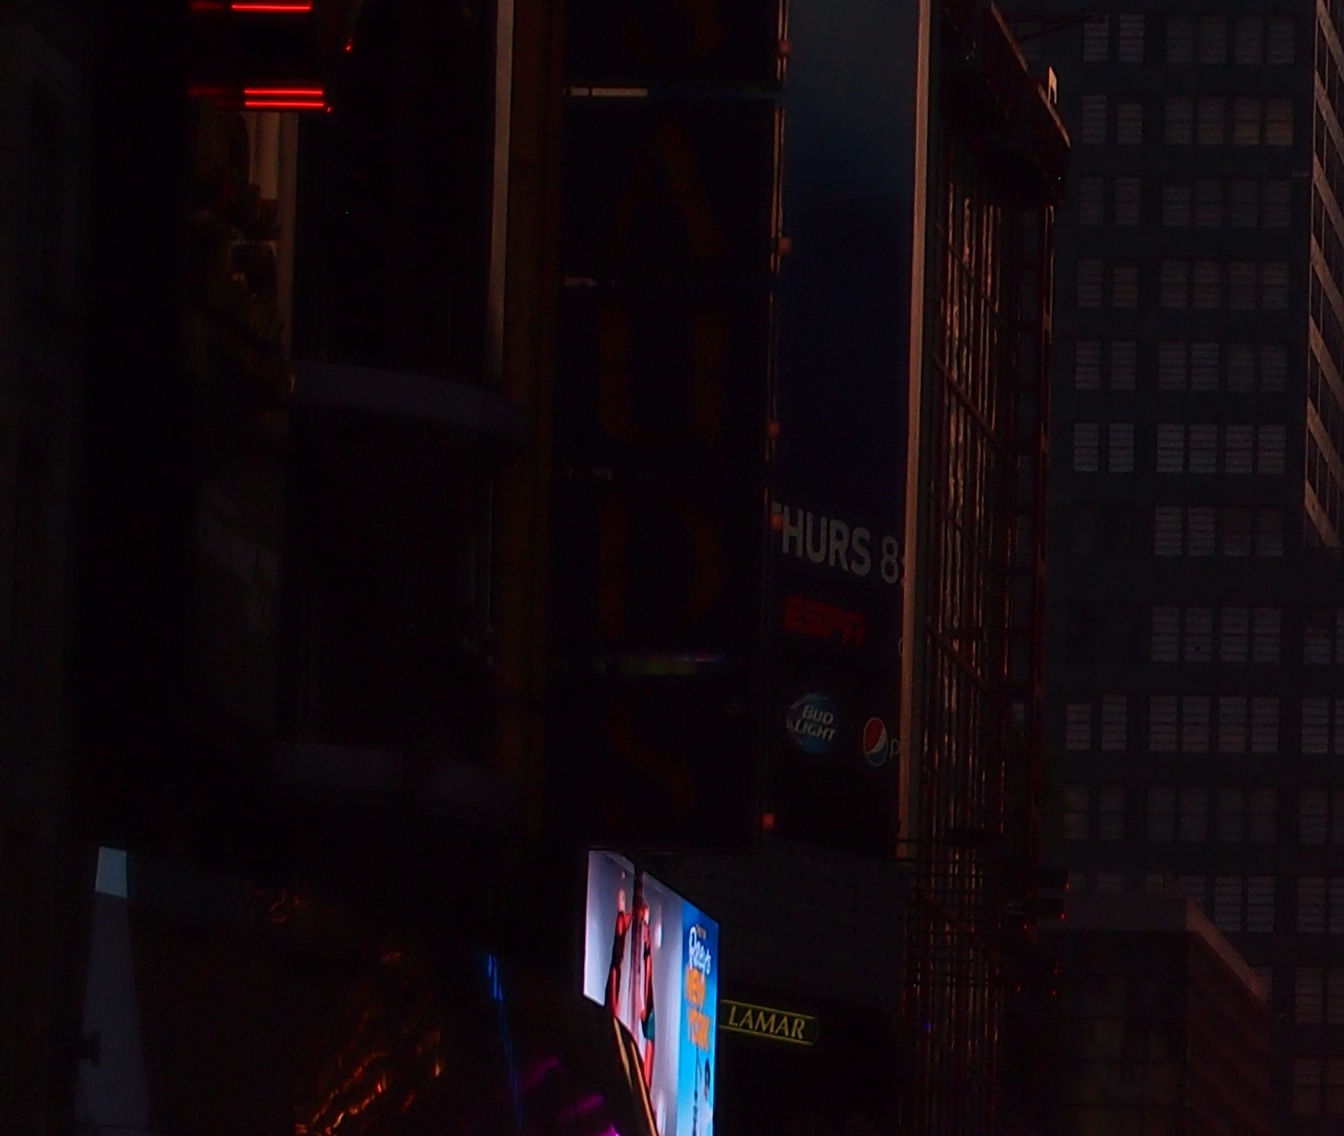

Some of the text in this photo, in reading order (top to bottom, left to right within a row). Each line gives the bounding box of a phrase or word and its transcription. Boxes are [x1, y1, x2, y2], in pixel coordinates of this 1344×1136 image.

[801, 704, 835, 725] BUD
[792, 717, 837, 743] LIGHT
[725, 1002, 807, 1040] LAMAR
